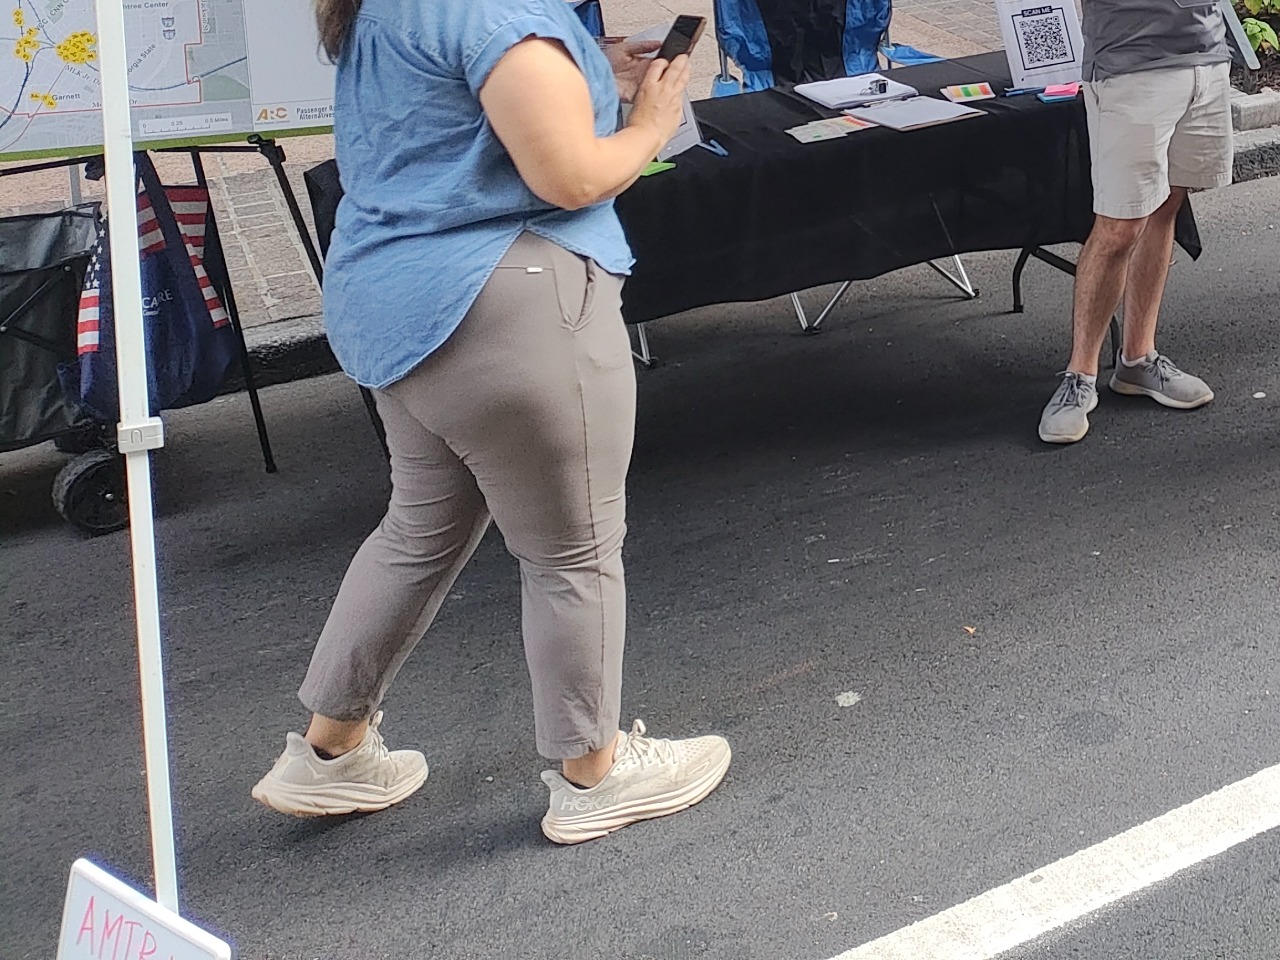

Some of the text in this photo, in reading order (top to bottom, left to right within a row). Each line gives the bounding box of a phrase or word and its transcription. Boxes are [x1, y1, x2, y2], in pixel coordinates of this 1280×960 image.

[1023, 9, 1041, 17] SCAN
[51, 93, 81, 101] Garnett
[76, 895, 174, 960] AMTR
